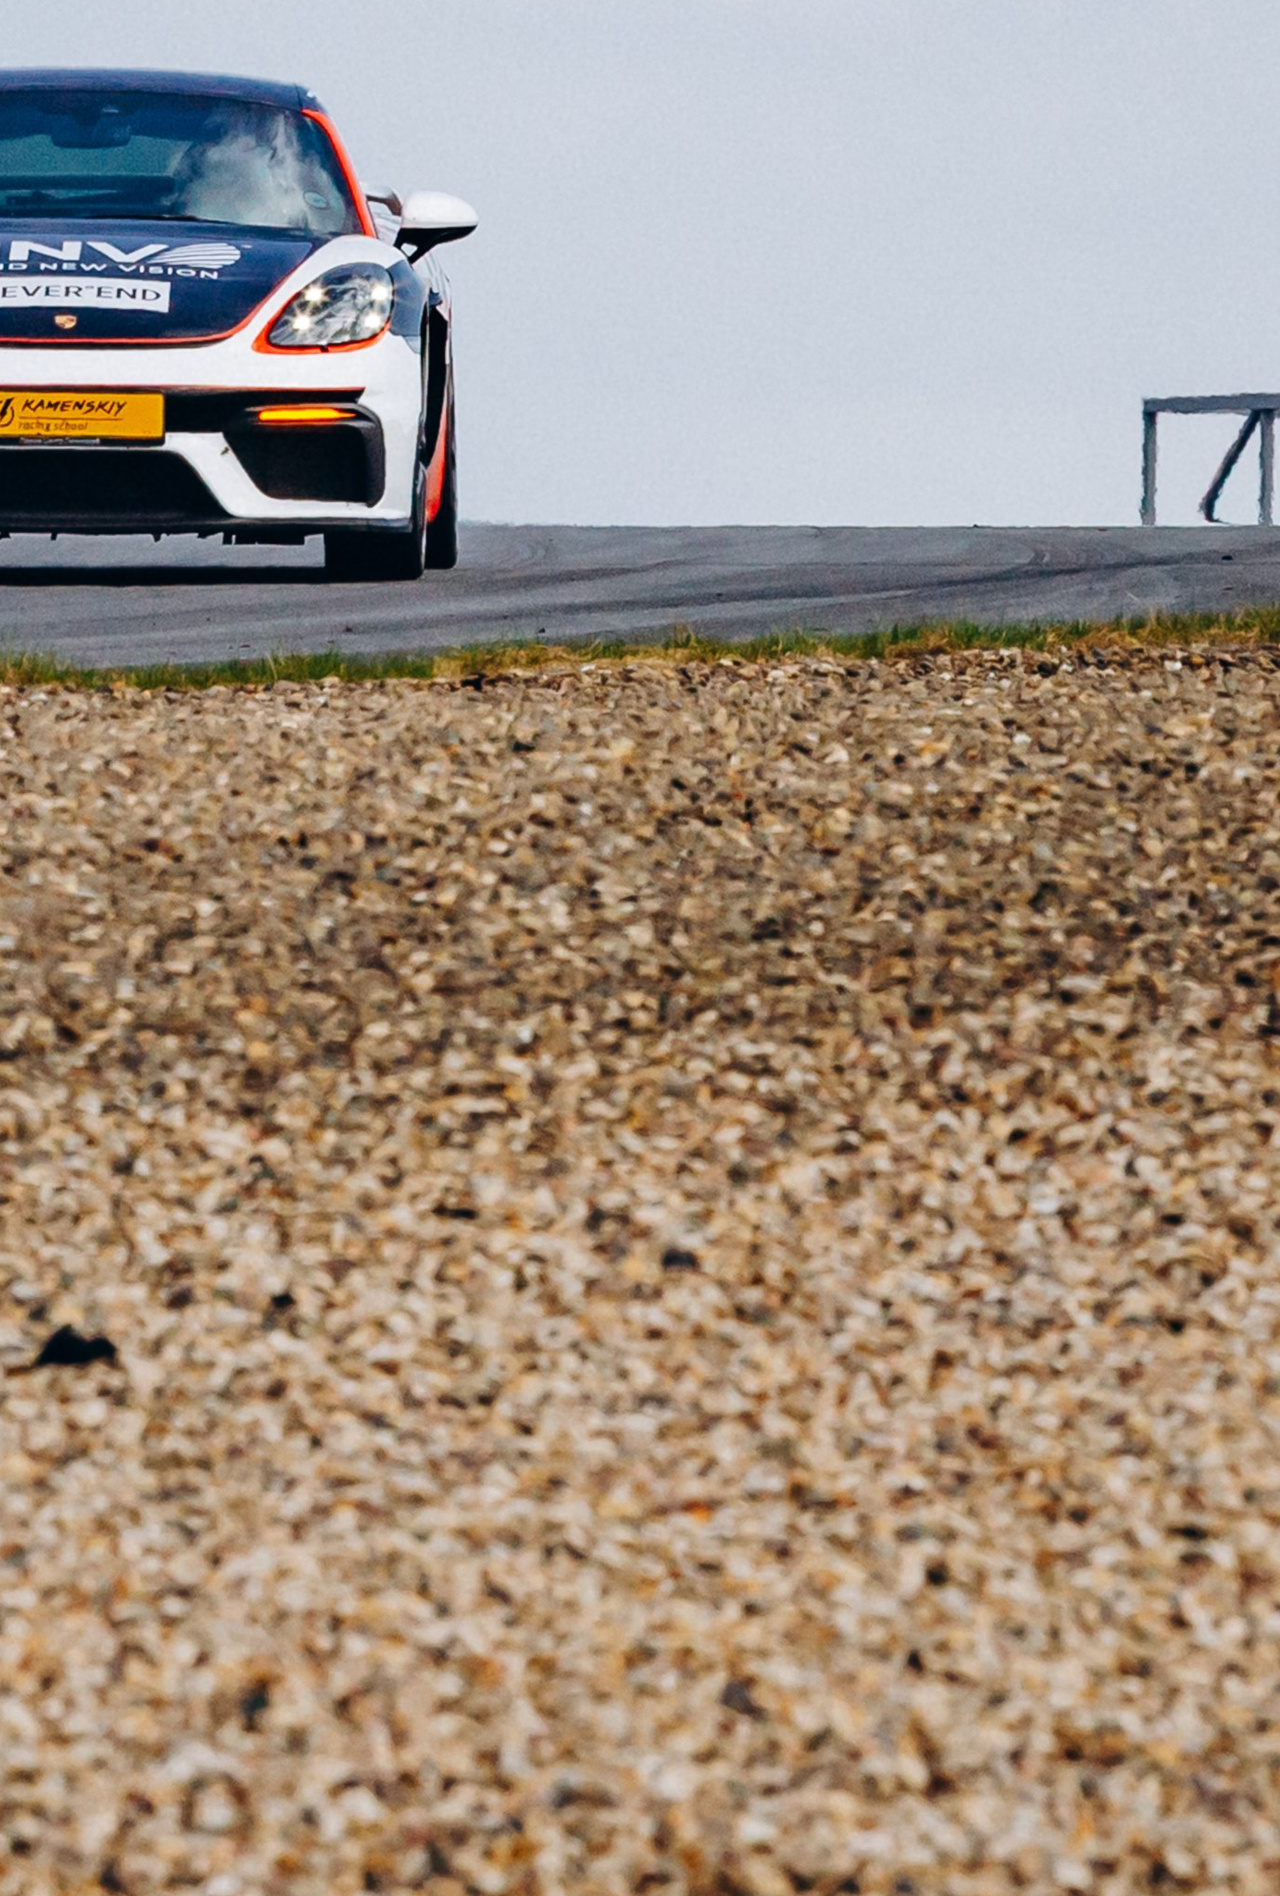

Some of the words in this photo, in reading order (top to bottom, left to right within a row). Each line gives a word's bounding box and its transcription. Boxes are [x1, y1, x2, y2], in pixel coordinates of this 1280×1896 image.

[40, 263, 107, 271] NEW
[119, 265, 218, 279] VISION
[22, 399, 127, 416] KAMENSKIY
[54, 420, 88, 431] school
